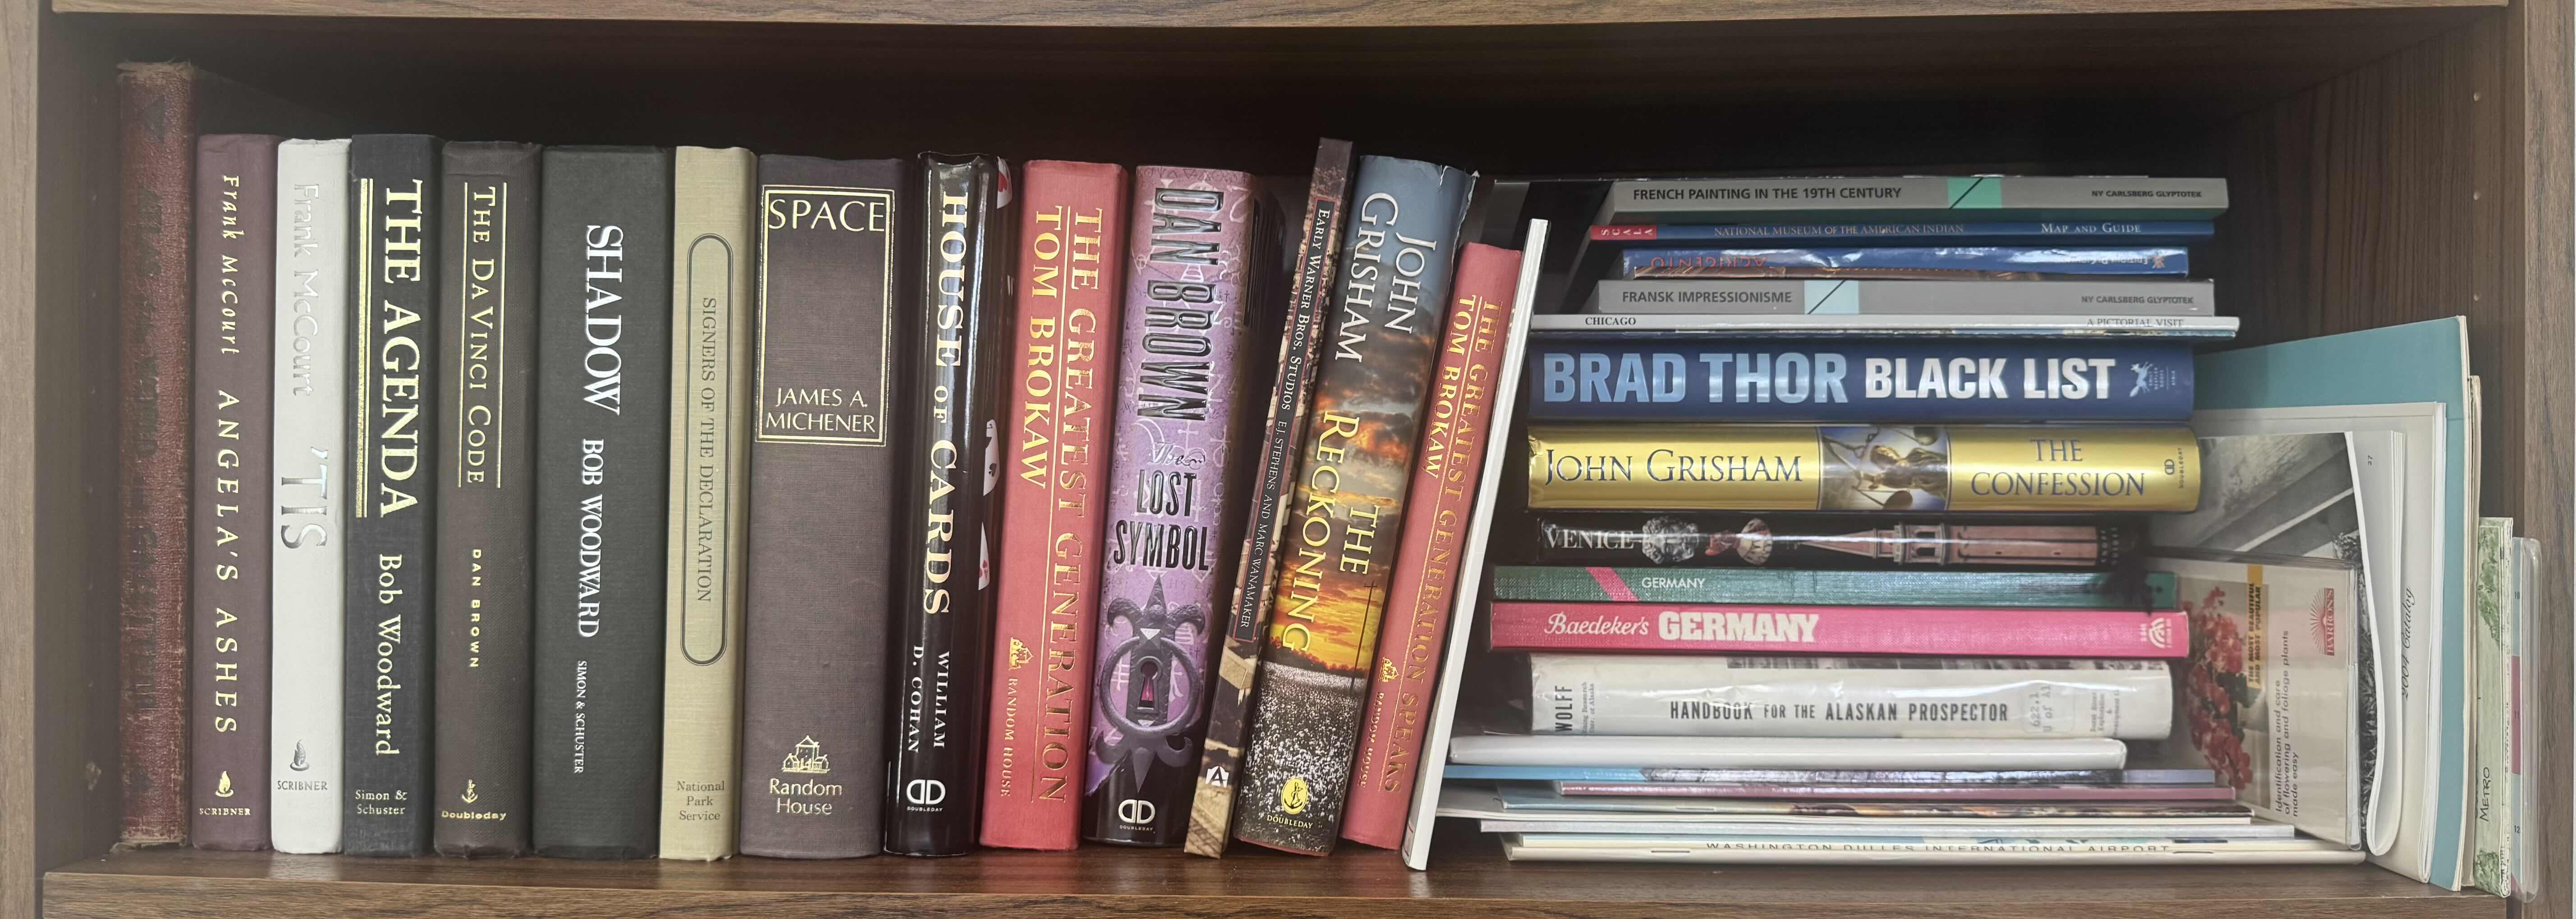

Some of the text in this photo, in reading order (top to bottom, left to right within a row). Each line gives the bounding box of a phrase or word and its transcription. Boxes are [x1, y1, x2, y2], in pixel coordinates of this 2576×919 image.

[768, 199, 885, 233] SPACE
[1633, 188, 1684, 200] FRENCH
[1688, 188, 1750, 200] PAINTING
[1754, 188, 1769, 200] IN
[1772, 188, 1799, 199] THE
[1803, 187, 1836, 199] 19TH
[1840, 187, 1902, 199] CENTURY
[294, 184, 320, 257] Frank
[1714, 222, 2141, 236] NATIONAL MUSEUM OF THE AMERICAN INDIAN MAP AND GUIDE
[1335, 193, 1399, 363] GRISHAM
[1385, 231, 1437, 334] JOHN
[1623, 291, 1674, 303] FRANSK
[1678, 291, 1792, 303] IMPRESSIONISME
[2147, 296, 2194, 304] GLYPTOTEK
[583, 225, 624, 415] SHADOW
[1137, 188, 1224, 421] DAN BROWN
[1585, 317, 1636, 326] CHICAGO
[293, 269, 319, 397] McCourt
[467, 186, 496, 484] THE DA VINCI CODE
[1020, 205, 1063, 490] TOM BROKAW
[775, 388, 868, 407] JAMES A.
[1423, 294, 1476, 478] TOM BROKAW
[1543, 353, 1686, 403] BRAD
[1699, 352, 1848, 403] THOR
[1865, 358, 2008, 399] BLACK
[2024, 358, 2116, 400] LIST
[766, 411, 875, 433] MICHENER
[923, 191, 969, 615] HOUSE OF CARDS
[1240, 208, 1331, 628] EARLY WARNER BROS. STUDIOS STEPHENS AND MARC WANAMAKER
[215, 175, 245, 732] Frank McCourt ANGELA'S ASHES
[375, 179, 423, 756] THE AGENDA Bob Woodward
[581, 439, 604, 485] BOB
[697, 298, 717, 602] SIGNERS OF THE DECLARATION
[1545, 449, 1803, 486] JOHN GRISHAM
[2030, 439, 2083, 463] THE
[1039, 207, 1103, 803] THE GREATEST GENERATION
[1137, 469, 1197, 516] LOST
[1971, 472, 2145, 496] CONFESSION
[1113, 520, 1209, 571] SYMBOL
[1283, 409, 1359, 653] RECKONING
[1339, 504, 1381, 575] THE
[1383, 299, 1504, 794] THE GREATEST GENERATION SPEAKS
[1545, 529, 1634, 549] VENICE
[578, 495, 603, 638] WOODWARD
[1642, 577, 1706, 589] GERMANY
[469, 549, 482, 668] DAN BROWN
[2401, 588, 2415, 648] Catalog
[2514, 591, 2520, 599] 10
[1544, 611, 1819, 643] Baedeker's GERMANY
[2281, 630, 2289, 666] plants
[576, 660, 587, 699] SIMON
[908, 645, 925, 754] D. COHAN
[934, 651, 950, 749] WILLIAM
[2281, 671, 2289, 712] foliage
[1555, 685, 1572, 732] WOLFF
[1670, 702, 2008, 722] HANDBOOK FOR THE ALASKAN PROSPECTOR
[2029, 692, 2040, 727] 622.1
[574, 712, 585, 774] SCHUSTER
[1000, 678, 1019, 798] RANDOM HOUSE
[277, 780, 328, 791] SCRIBNER
[677, 780, 725, 792] National
[770, 778, 842, 796] Random
[2274, 737, 2282, 812] Identification
[2282, 743, 2291, 798] flowering
[199, 808, 251, 816] SCRIBNER
[355, 790, 407, 801] Simon &
[357, 804, 405, 815] Schuster
[442, 810, 506, 821] Doubleday
[679, 810, 721, 821] Service
[686, 796, 713, 806] Park
[777, 797, 833, 815] House
[2283, 801, 2291, 815] of
[2479, 767, 2491, 821] METRO
[1267, 813, 1313, 828] DOUBLEDAY
[2514, 825, 2520, 833] 12
